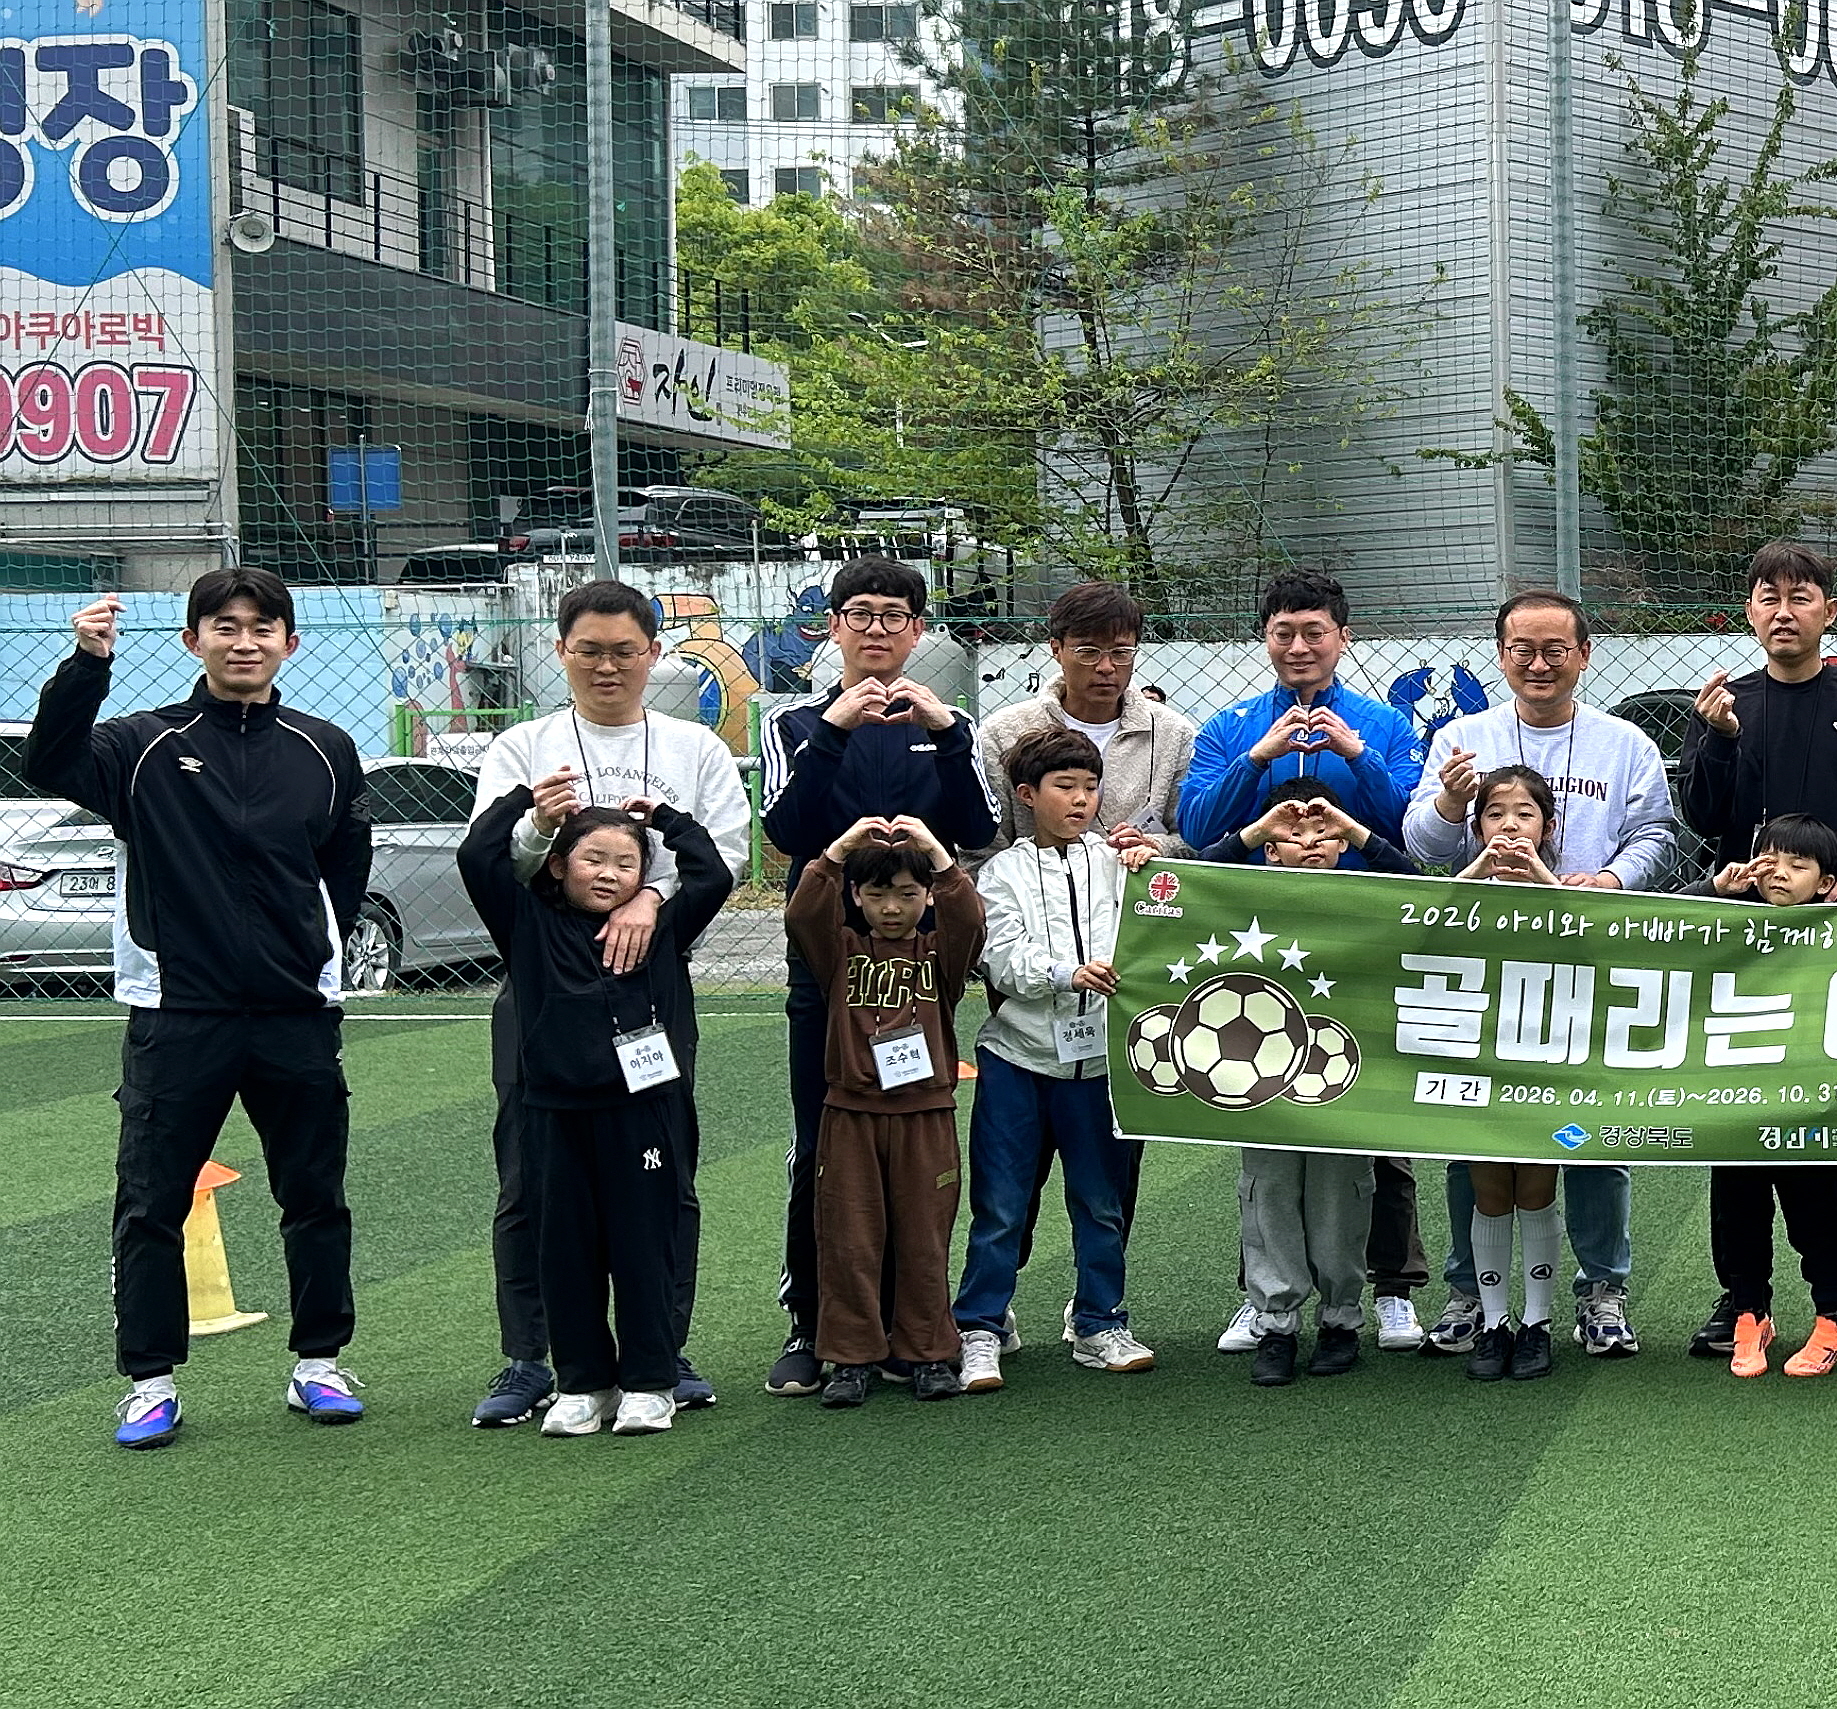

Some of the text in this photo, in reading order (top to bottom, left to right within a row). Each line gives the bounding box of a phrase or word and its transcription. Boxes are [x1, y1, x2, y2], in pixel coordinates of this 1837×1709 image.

[596, 766, 621, 778] LOS
[621, 768, 680, 804] ANGELES
[1545, 776, 1609, 802] LIGION
[1134, 901, 1183, 917] Caritas
[1399, 900, 1481, 932] 2026
[1496, 909, 1595, 937] 아이와
[1608, 916, 1731, 945] 아빠가
[1393, 953, 1796, 1069] 골때리는
[1498, 1084, 1562, 1106] 2026.
[1569, 1088, 1604, 1107] 04.
[1600, 1125, 1694, 1149] 경상북도
[1758, 1126, 1829, 1150] 경산시
